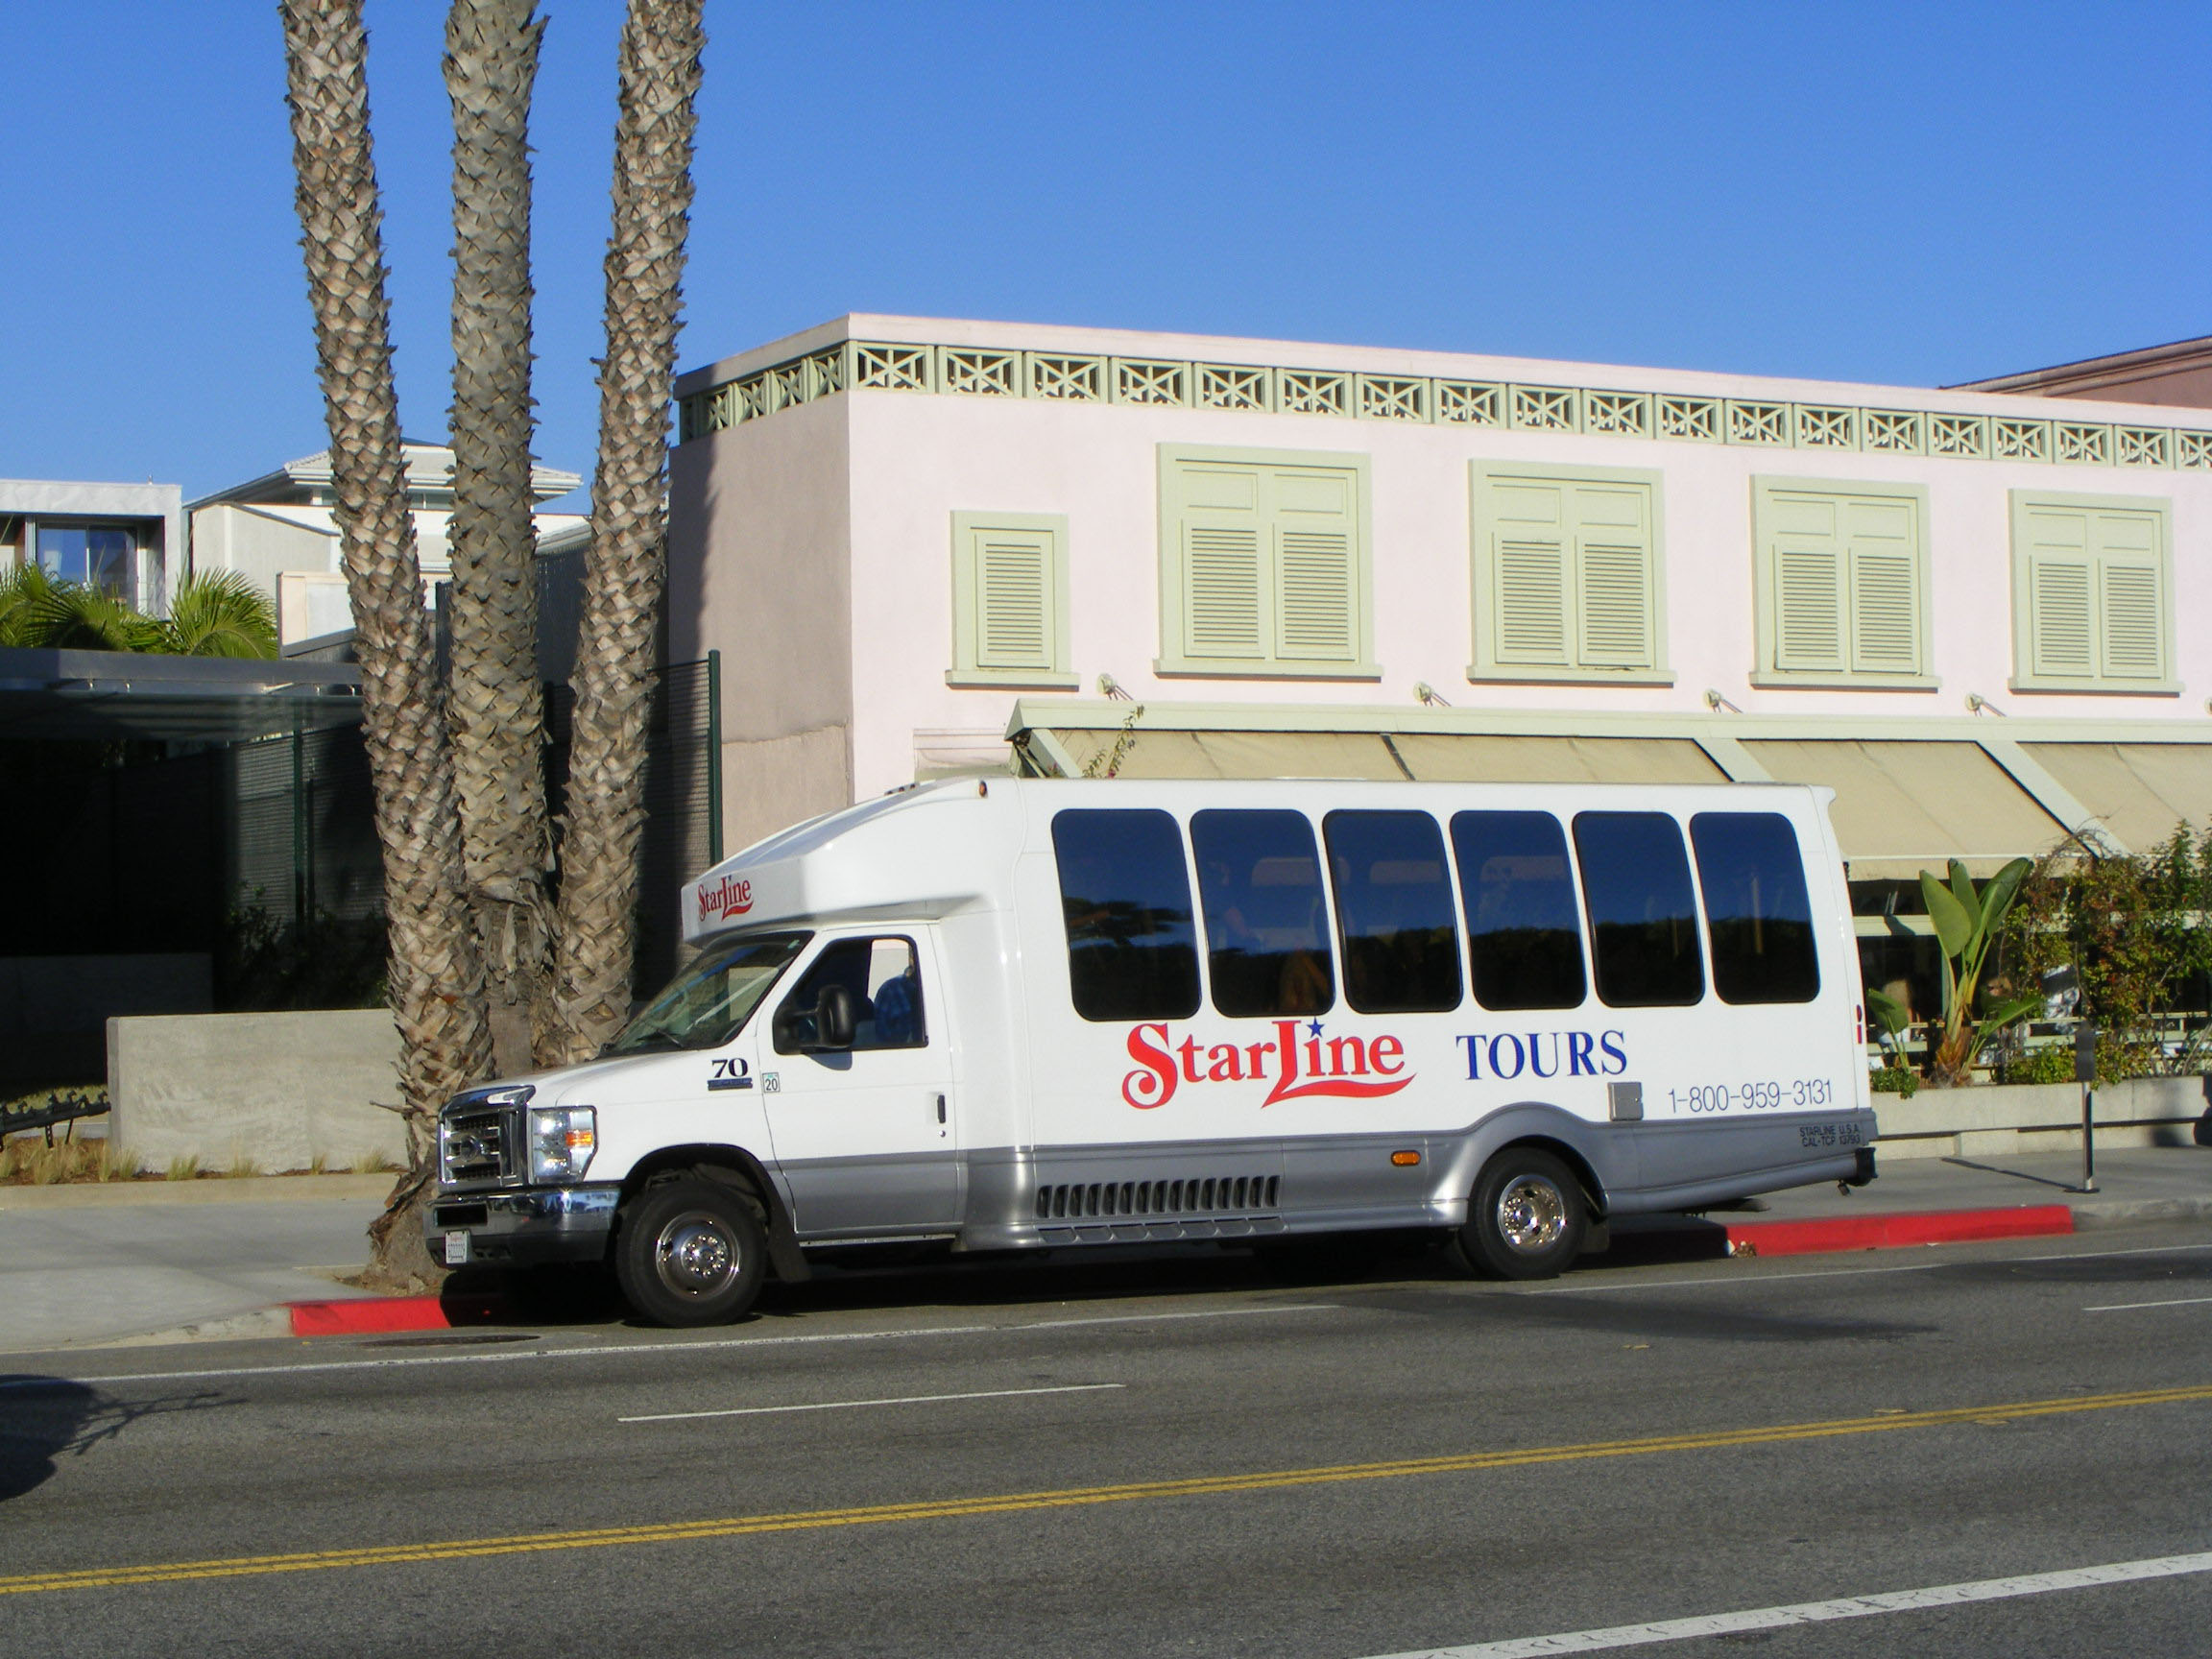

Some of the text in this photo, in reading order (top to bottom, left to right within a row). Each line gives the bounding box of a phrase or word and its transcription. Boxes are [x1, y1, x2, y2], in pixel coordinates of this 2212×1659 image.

[698, 876, 754, 922] StarLine
[711, 1058, 748, 1078] 70
[1121, 1018, 1627, 1110] StarLine TOURS
[765, 1078, 779, 1091] 20
[1668, 1079, 1832, 1114] 1-800-959-3131
[1799, 1124, 1836, 1137] STARLINE
